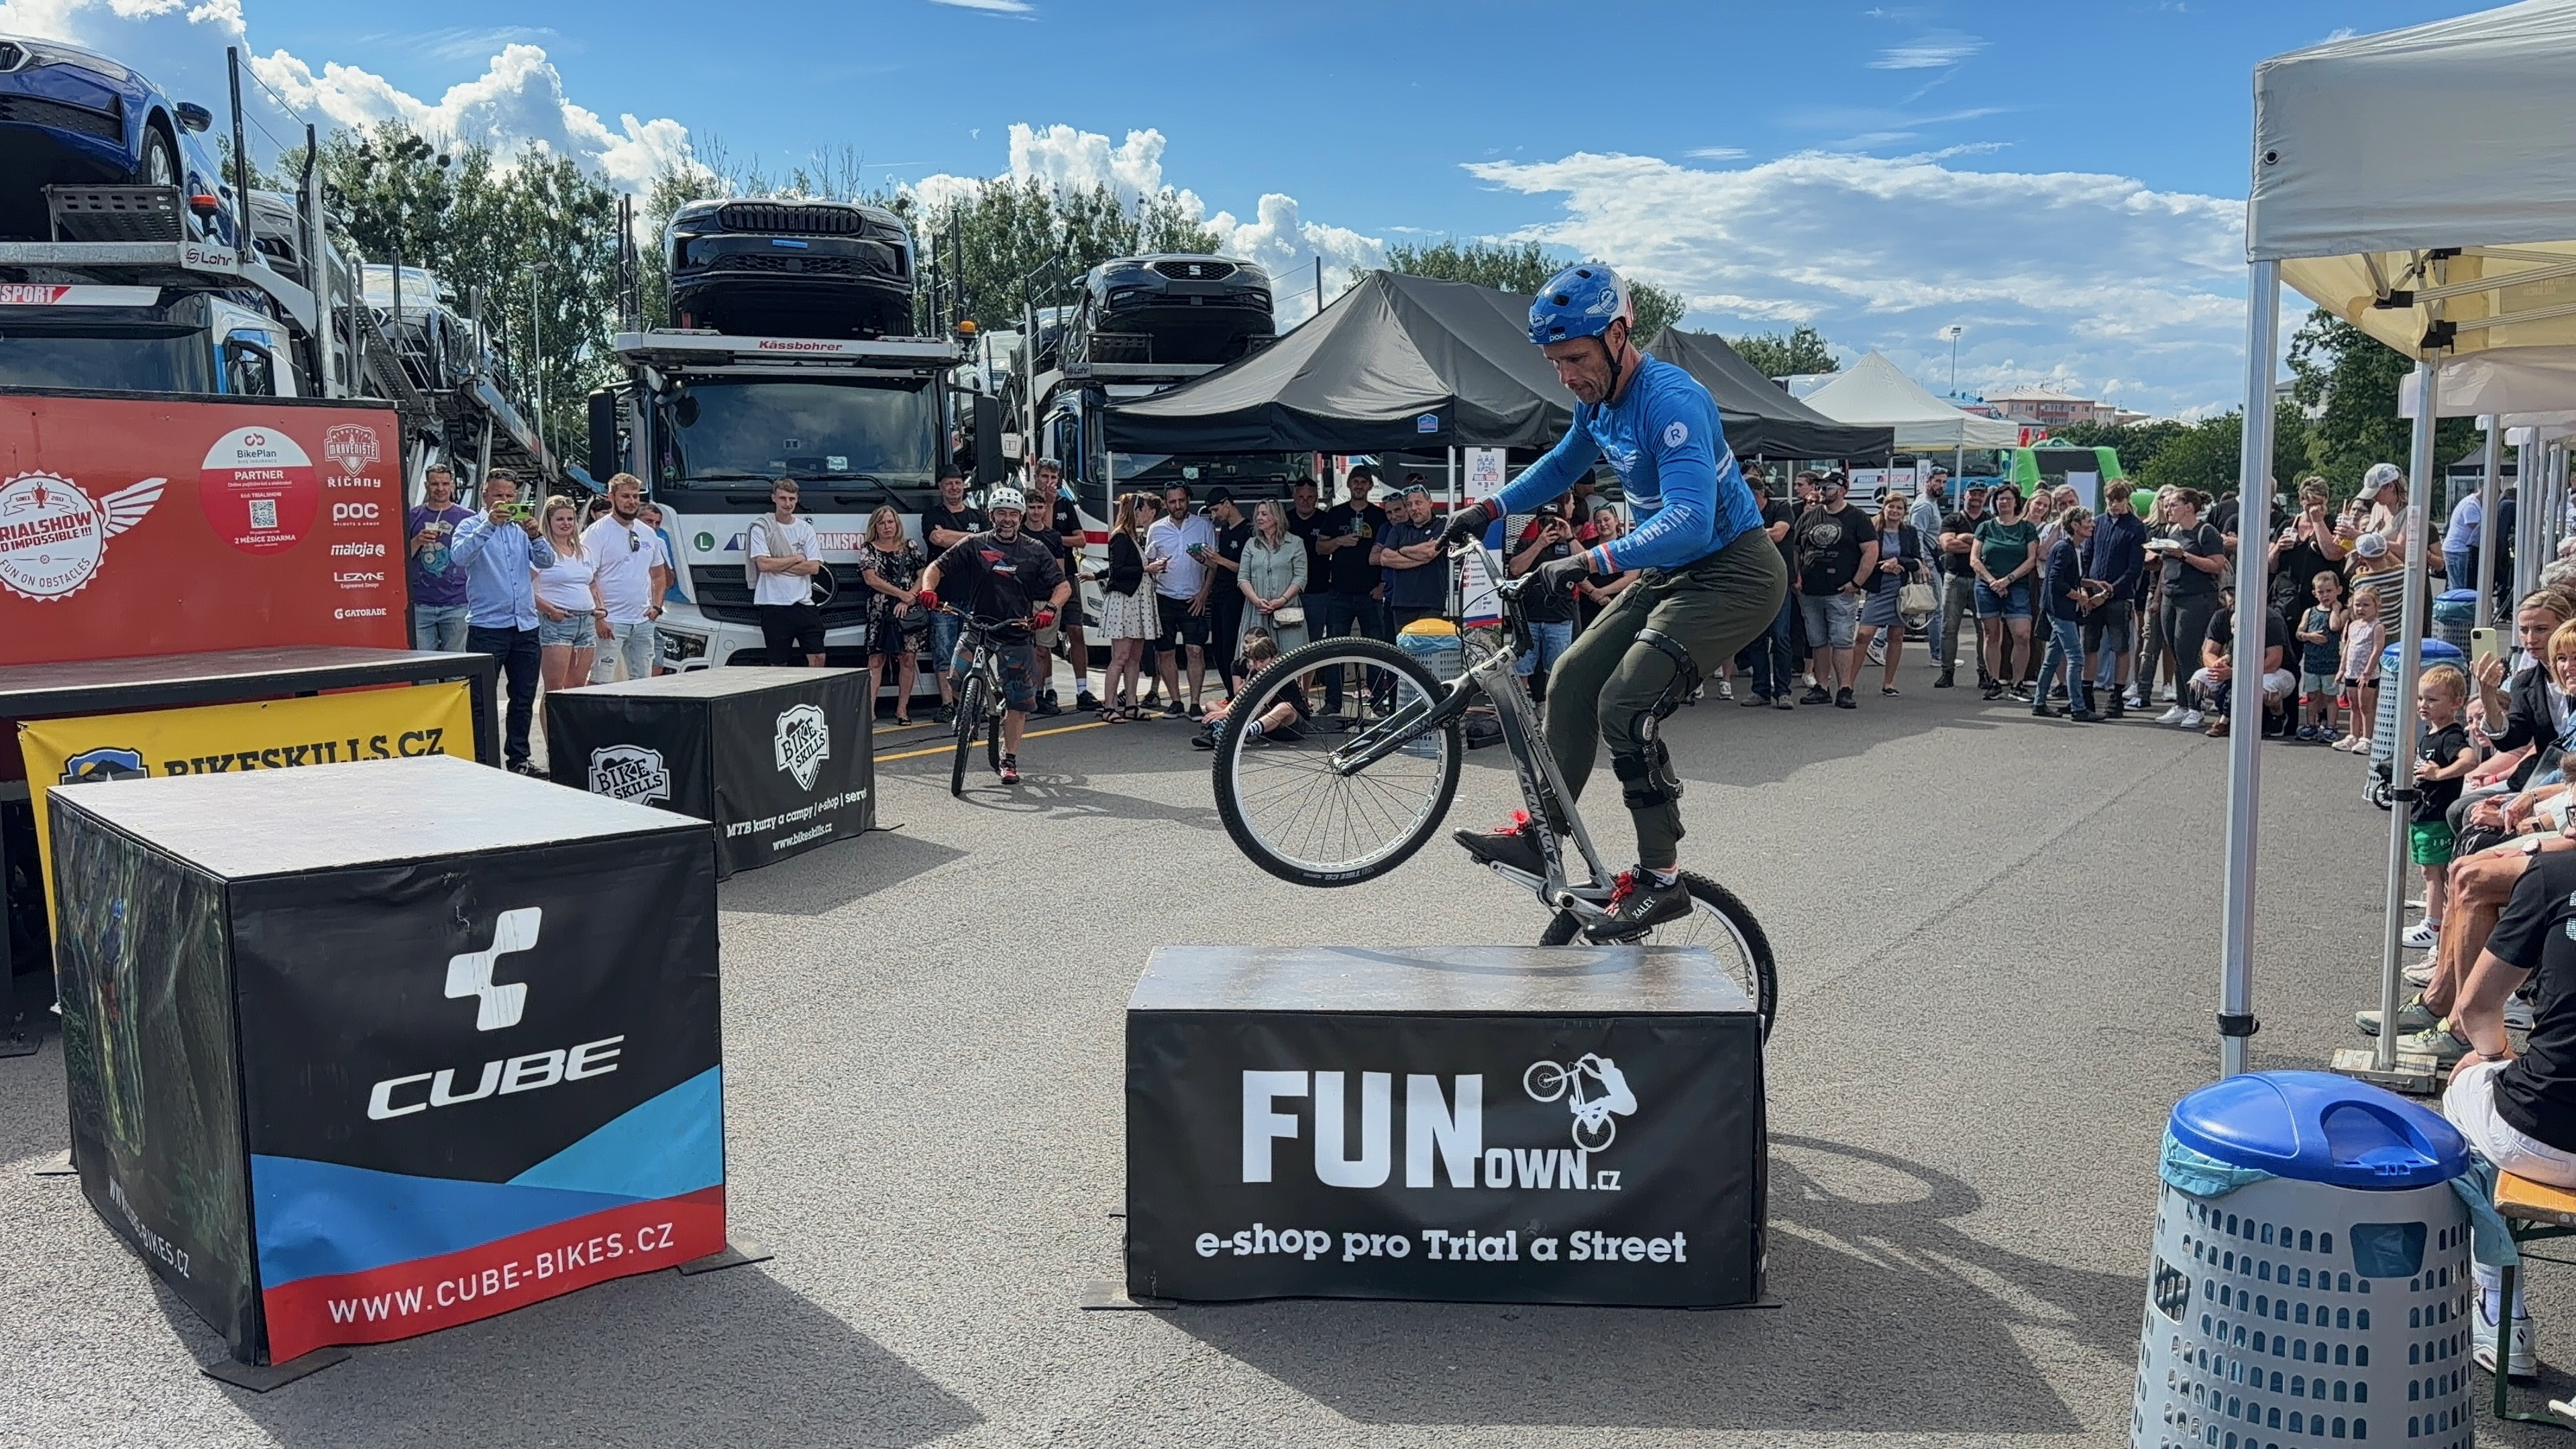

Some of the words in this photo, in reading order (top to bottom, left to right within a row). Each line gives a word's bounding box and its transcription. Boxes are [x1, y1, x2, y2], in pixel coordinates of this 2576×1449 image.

[201, 252, 232, 266] Lohr
[0, 284, 56, 303] SPORT
[759, 340, 843, 351] Kässbohrer
[1670, 428, 1681, 441] R
[237, 449, 276, 458] BikePlan
[235, 470, 284, 480] PARTNER
[0, 511, 92, 541] RIALSHOW
[11, 528, 80, 551] IMPOSSIBLE
[266, 534, 296, 542] ZDARMA
[330, 541, 374, 557] maloja
[817, 533, 865, 549] RANSPO
[0, 559, 20, 579] FUN
[21, 574, 36, 586] ON
[39, 557, 91, 588] OBSTACLES
[333, 572, 384, 582] LEZYNE
[344, 608, 387, 617] GATORADE
[782, 716, 817, 763] BIKE
[795, 733, 826, 769] SKILLS
[596, 758, 650, 792] BIKE
[614, 774, 663, 800] SKILLS
[727, 821, 752, 838] MTB
[753, 816, 777, 833] kurzy
[778, 816, 784, 825] a
[786, 805, 814, 822] campy
[818, 796, 839, 813] e-shop
[773, 822, 833, 851] www.bikeskills.cz
[367, 1034, 625, 1120] CUBE
[1195, 1223, 1332, 1261] e-shop
[1342, 1232, 1411, 1263] pro
[1422, 1230, 1519, 1262] Trial
[1530, 1234, 1558, 1262] a
[1569, 1230, 1686, 1263] Street
[327, 1222, 674, 1324] WWW.CUBE-BIKES.CZ
